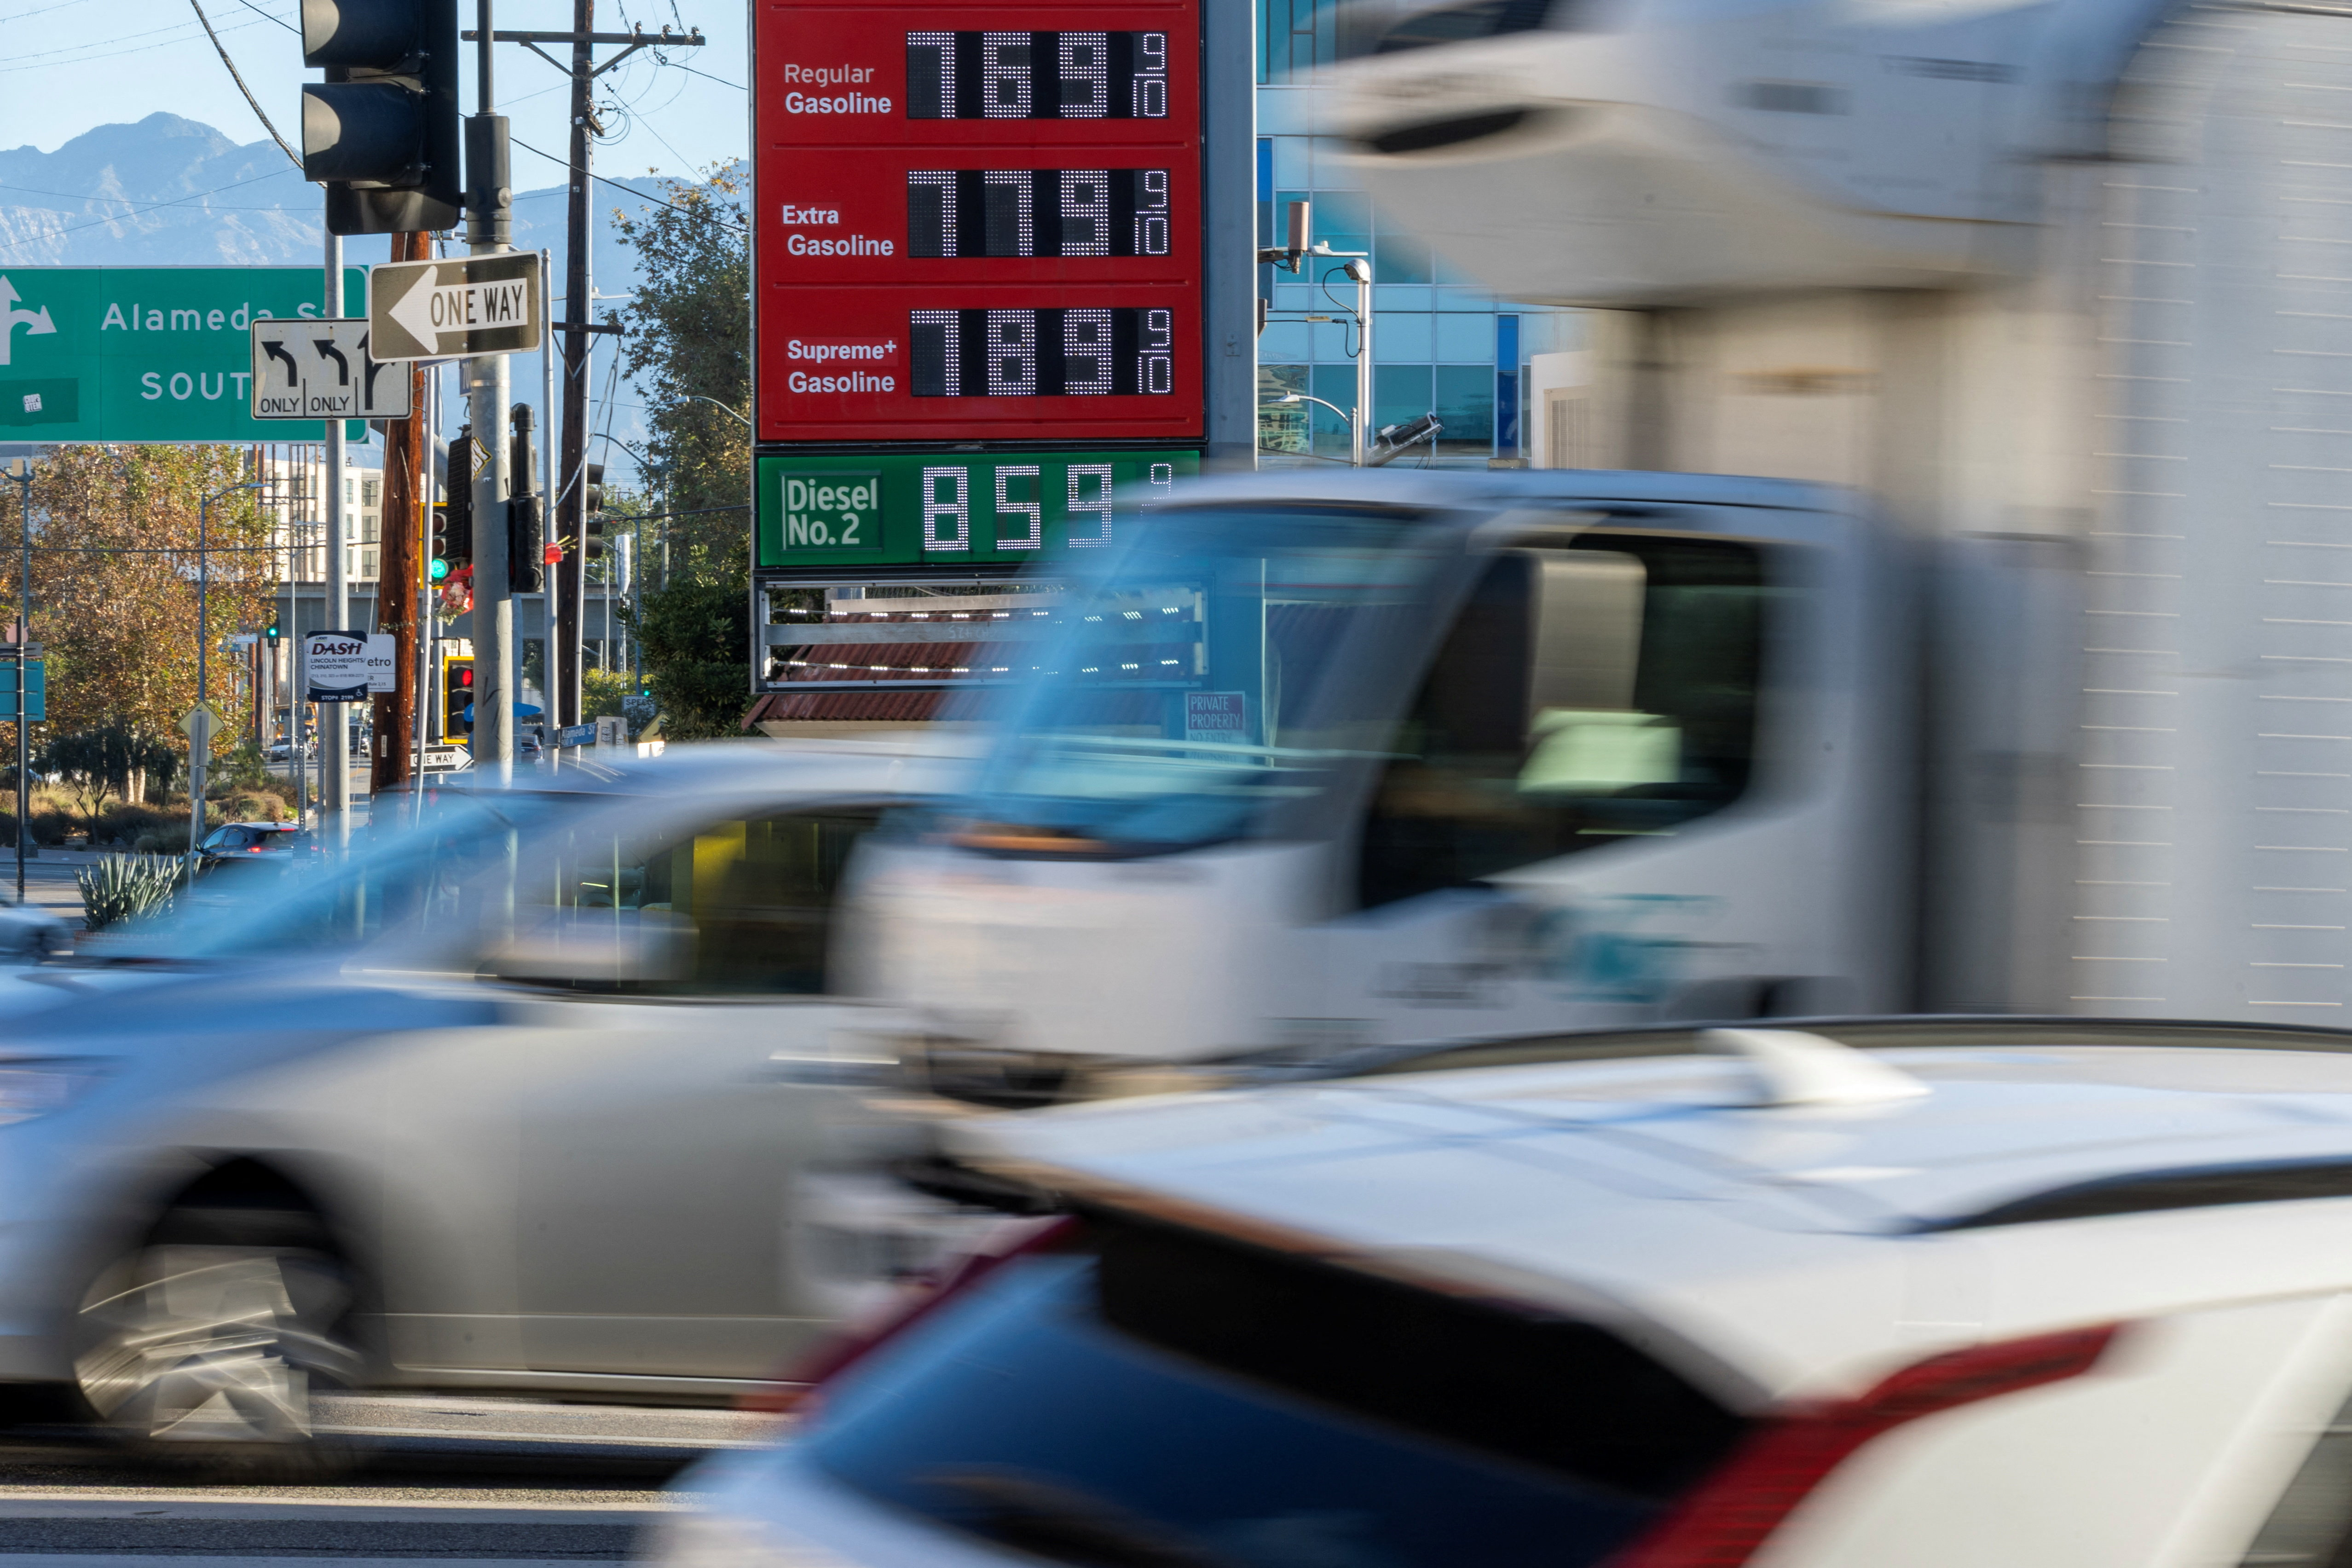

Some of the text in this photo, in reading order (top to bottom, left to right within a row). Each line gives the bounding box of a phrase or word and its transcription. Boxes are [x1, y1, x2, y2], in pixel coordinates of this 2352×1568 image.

[785, 63, 875, 87] Regular
[785, 92, 892, 114] Gasoline
[783, 205, 839, 225] Extra
[787, 234, 894, 256] Gasoline
[297, 302, 325, 318] S
[431, 284, 523, 327] ONE WAY
[787, 340, 897, 363] Supreme+
[140, 371, 251, 400] SOUT
[788, 371, 895, 393] Gasoline
[260, 398, 300, 413] ONLY
[311, 397, 350, 411] ONLY
[788, 478, 878, 511] Diesel
[788, 512, 860, 545] No. 2
[312, 642, 363, 655] DASH
[367, 657, 391, 666] etro
[1190, 696, 1229, 711] PRIVATE
[1191, 713, 1240, 728] PROPERTY
[561, 726, 586, 739] Alameda
[588, 725, 595, 735] St
[435, 754, 454, 763] WAY
